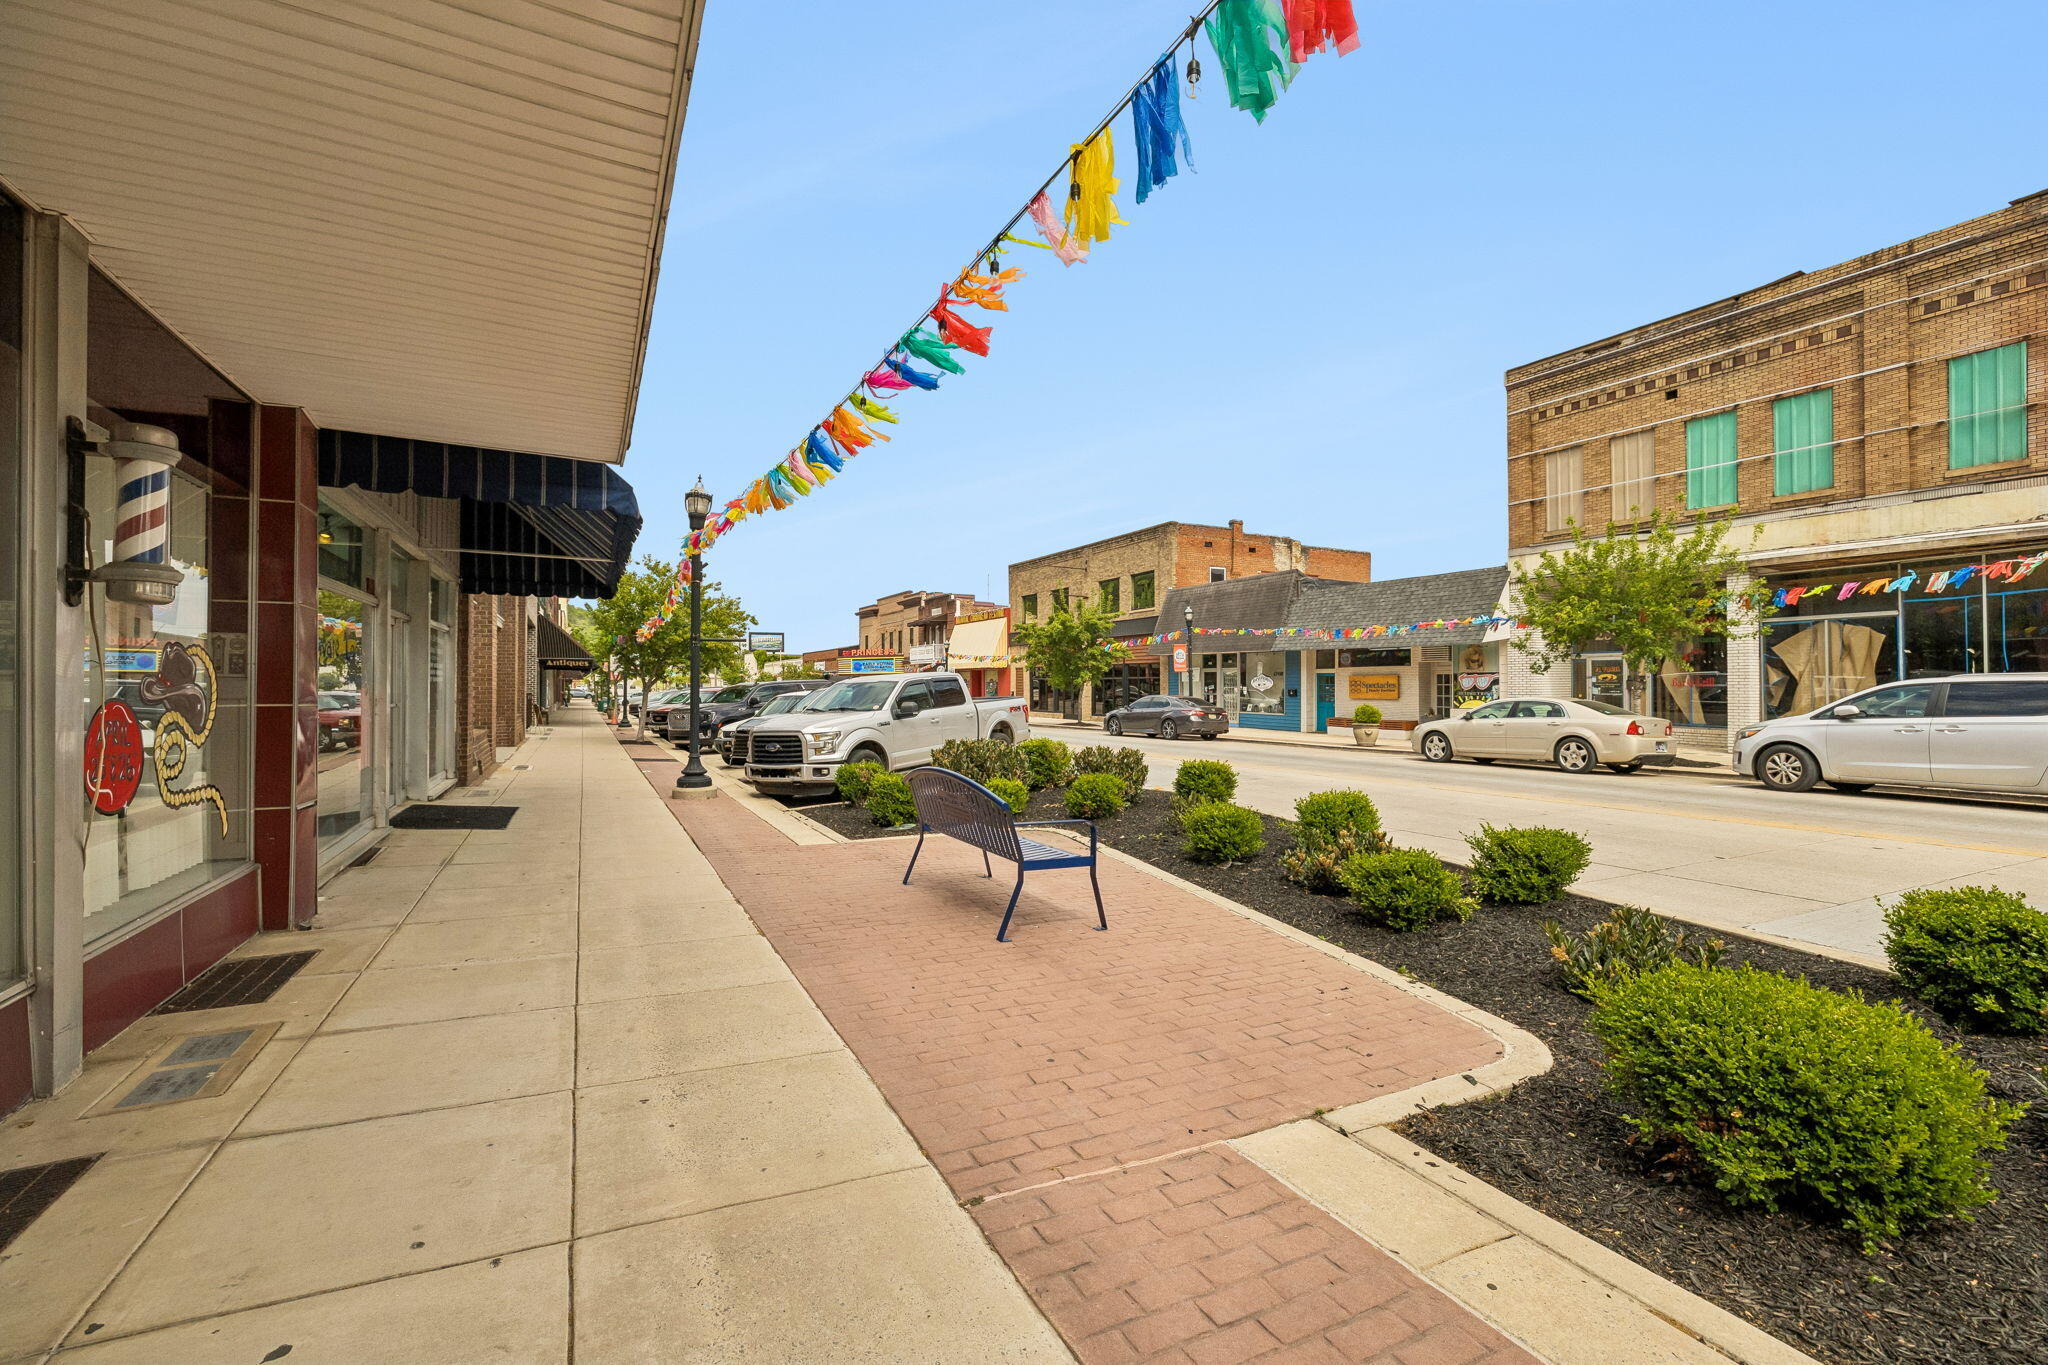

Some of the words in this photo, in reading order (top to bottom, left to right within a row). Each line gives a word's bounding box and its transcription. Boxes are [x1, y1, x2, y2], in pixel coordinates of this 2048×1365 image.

[852, 648, 894, 656] PRINCESS
[546, 659, 589, 667] Antiques
[1361, 681, 1396, 689] Spectacles
[96, 720, 132, 747] APRIL
